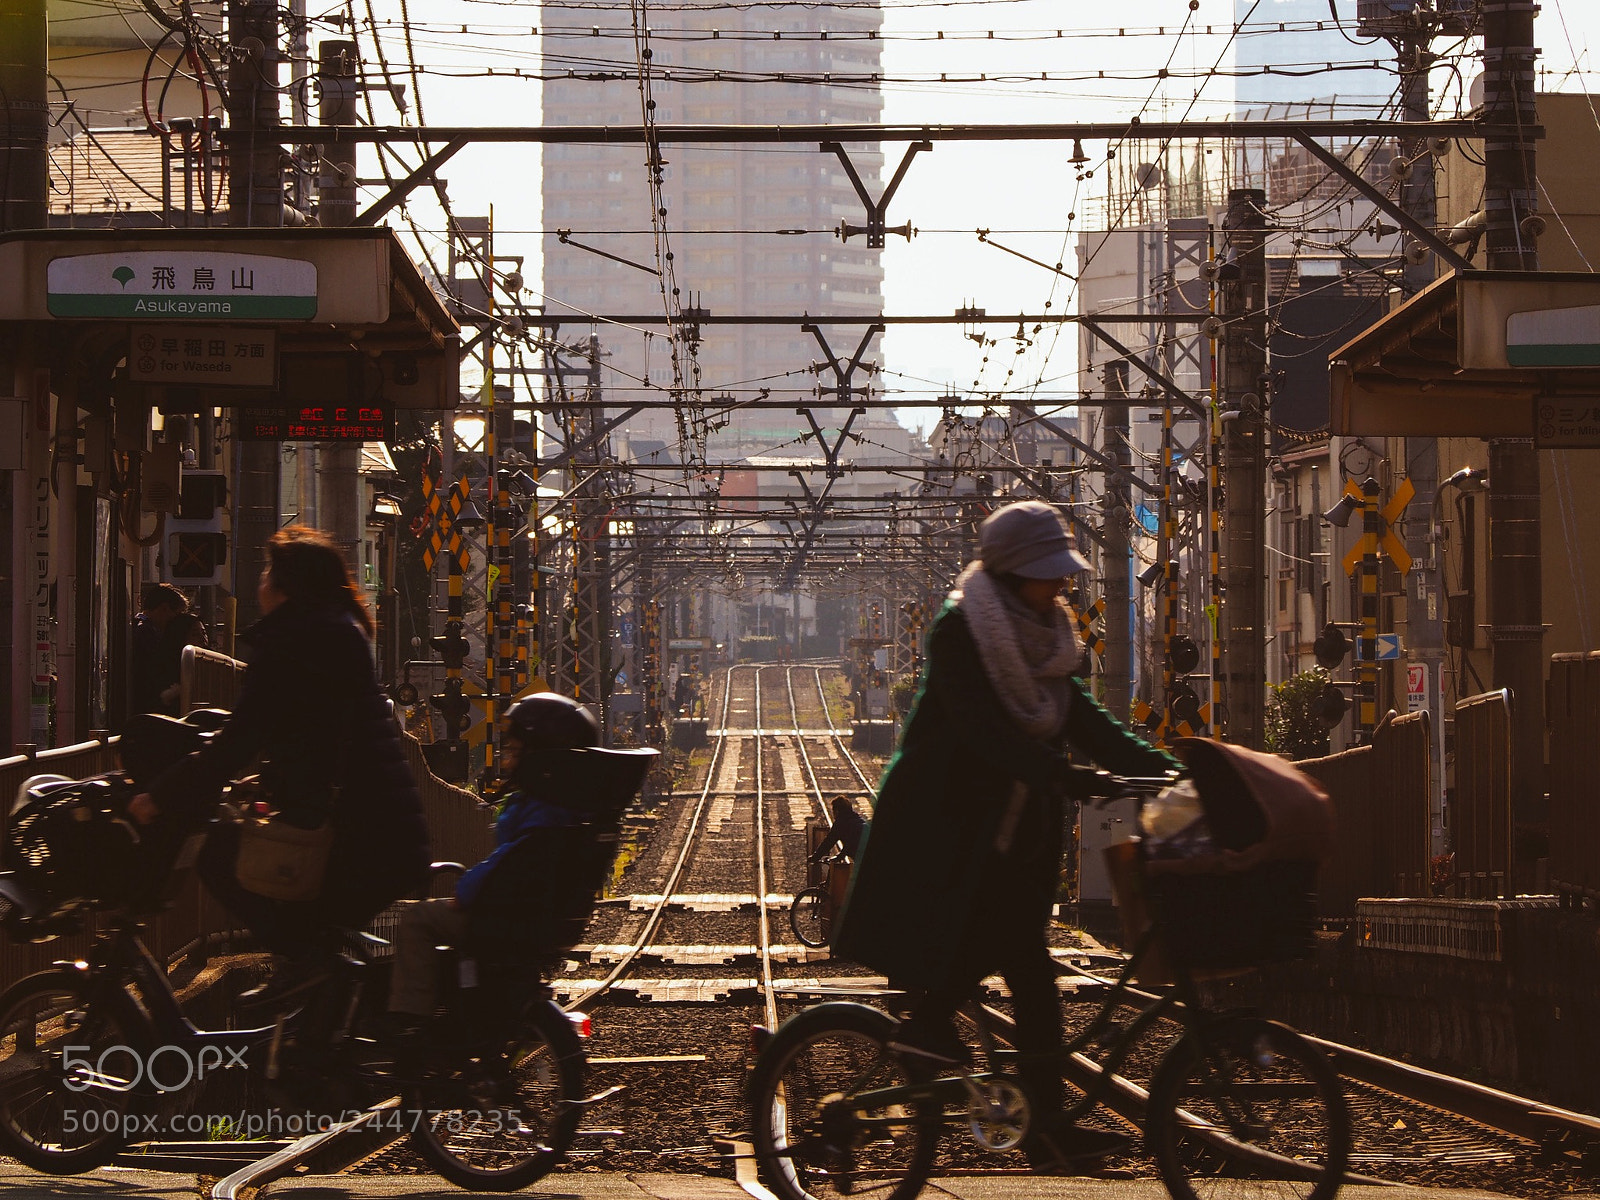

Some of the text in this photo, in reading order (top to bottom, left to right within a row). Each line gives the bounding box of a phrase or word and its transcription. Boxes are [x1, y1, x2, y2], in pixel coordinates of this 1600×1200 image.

[152, 266, 254, 291] 飛鳥山
[134, 298, 232, 314] Asukayama
[160, 360, 232, 373] for Waseda
[1559, 425, 1576, 436] for
[1578, 425, 1600, 436] Min
